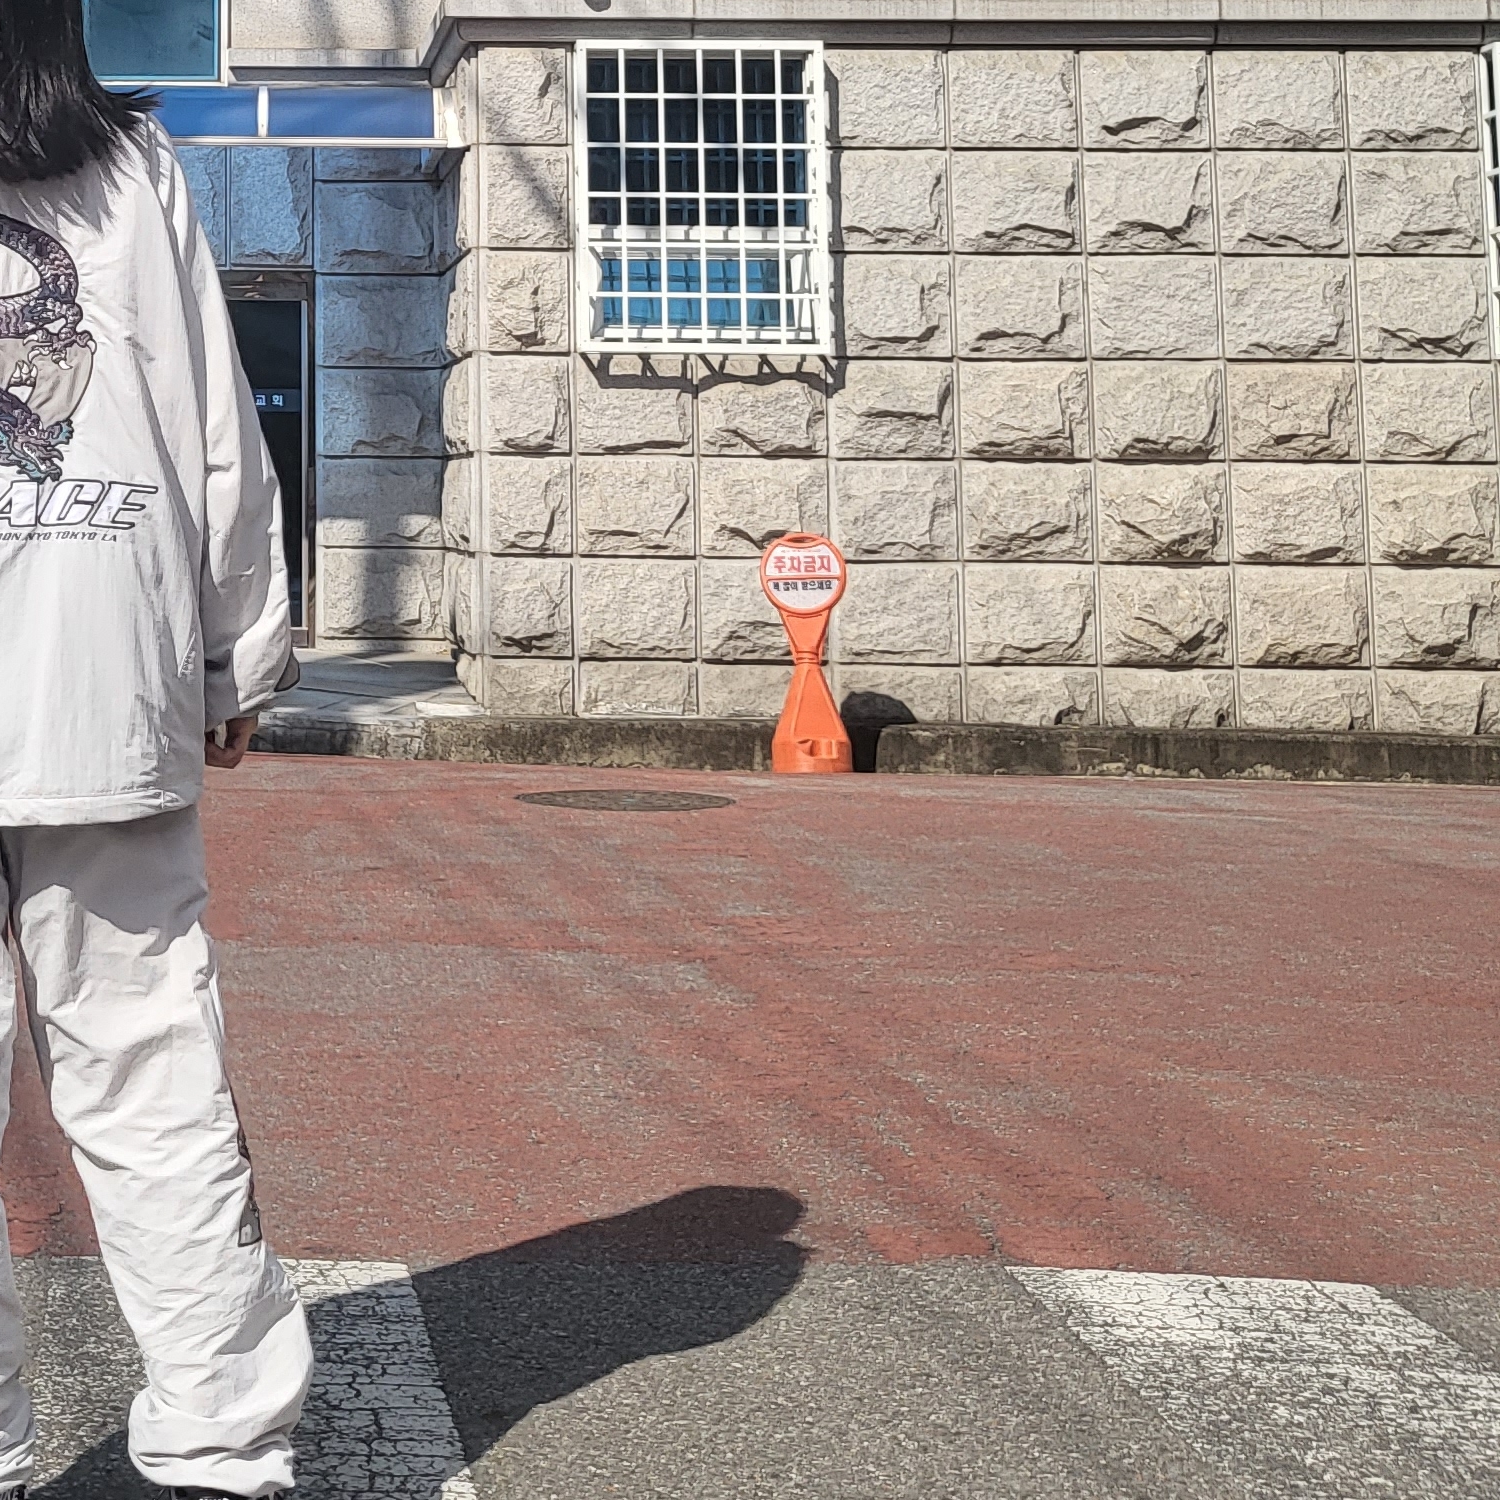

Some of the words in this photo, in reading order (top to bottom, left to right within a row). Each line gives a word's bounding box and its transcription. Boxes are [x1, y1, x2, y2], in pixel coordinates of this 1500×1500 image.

[55, 530, 98, 541] TOKYO
[101, 534, 117, 542] LA
[773, 554, 832, 573] 주차금지
